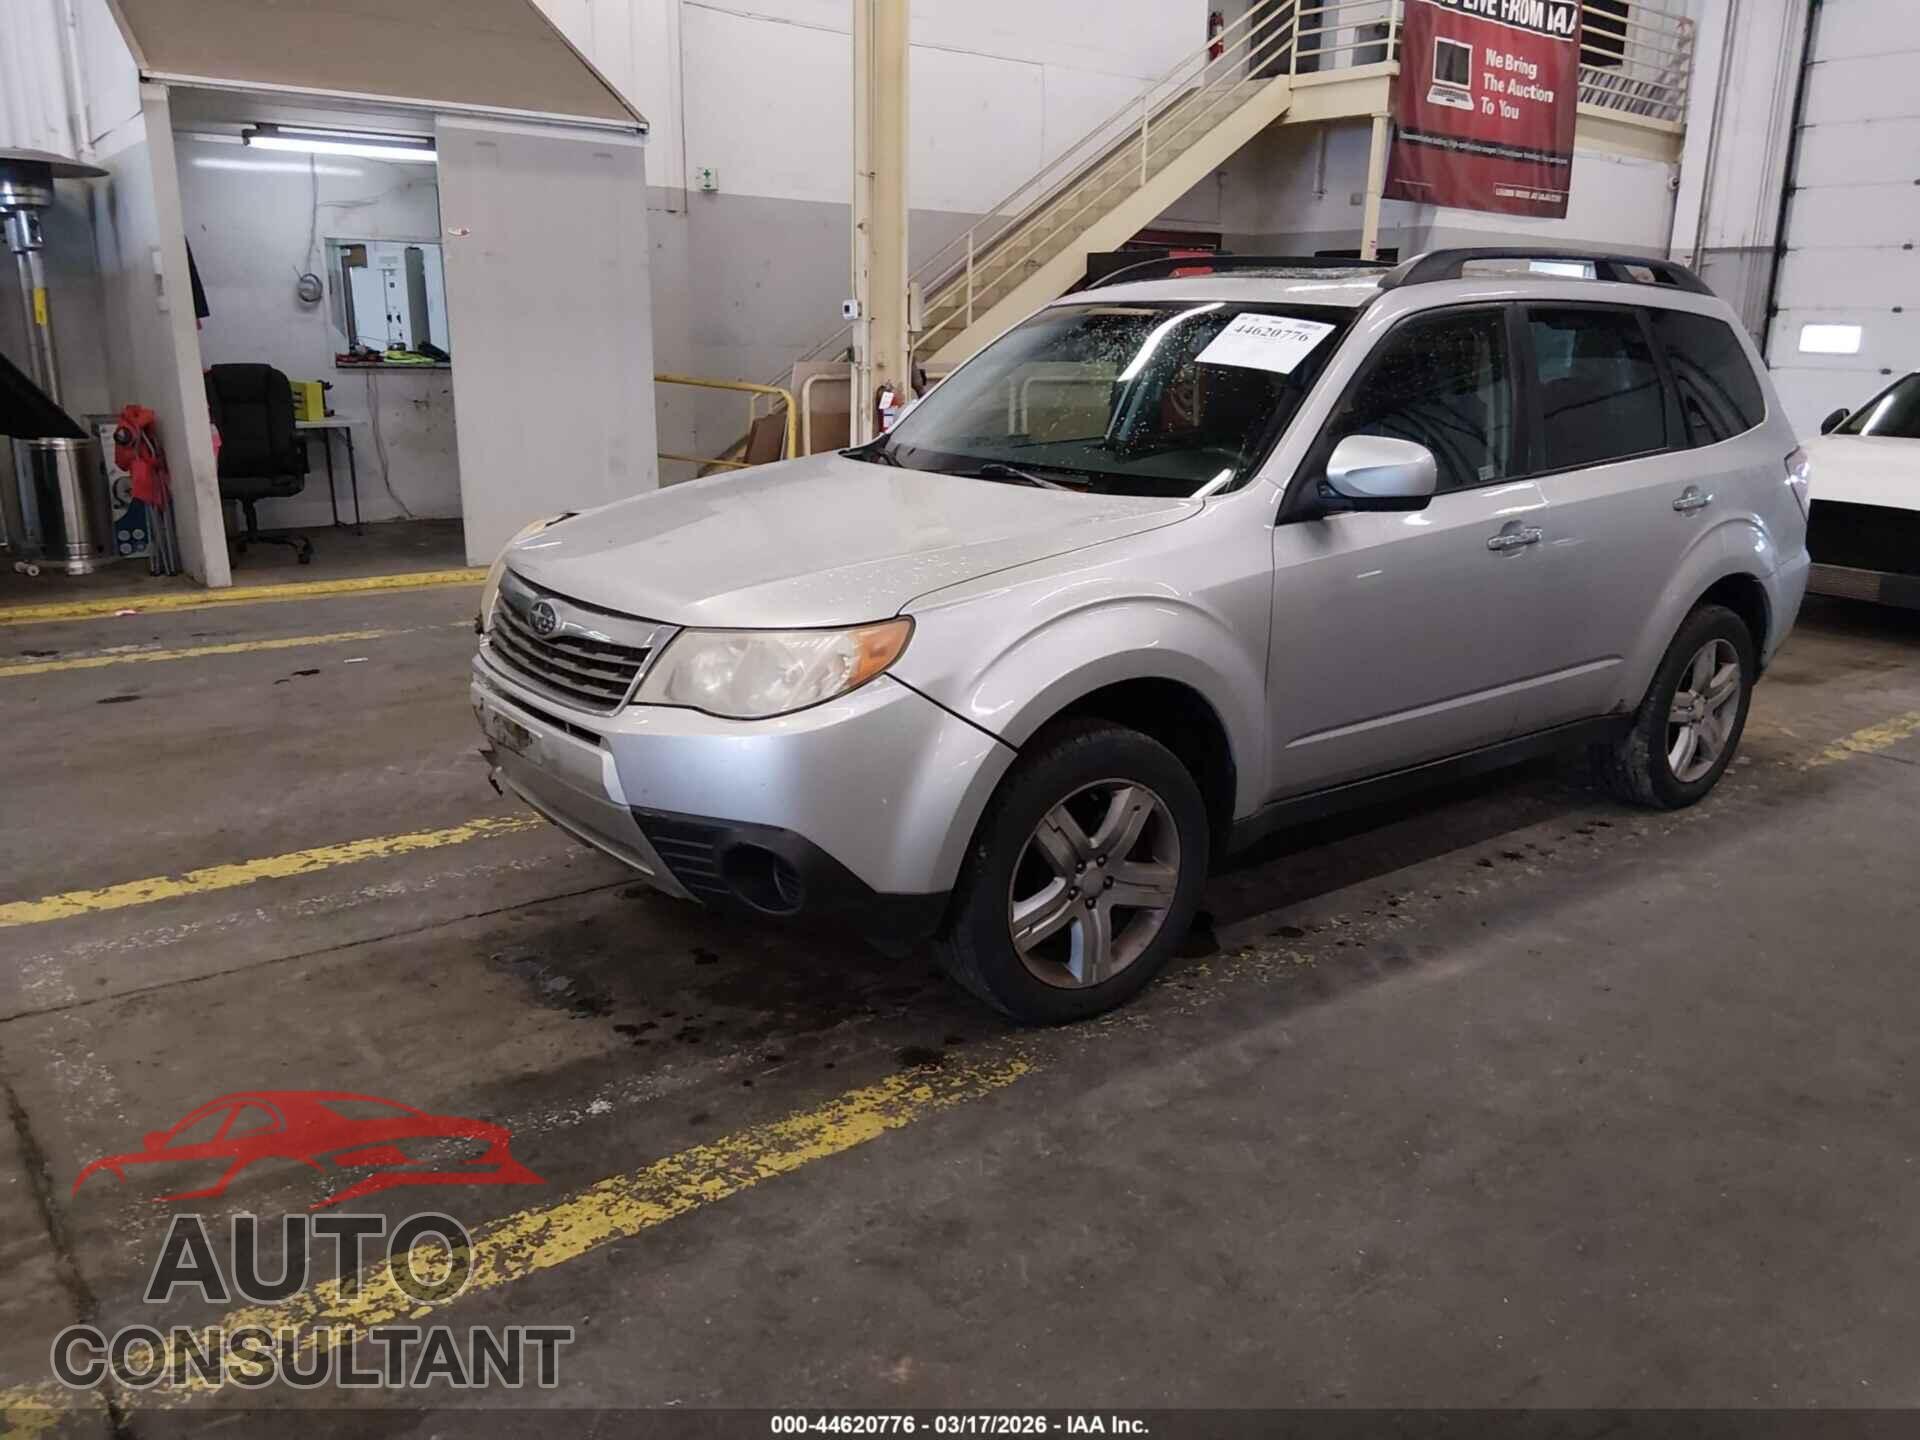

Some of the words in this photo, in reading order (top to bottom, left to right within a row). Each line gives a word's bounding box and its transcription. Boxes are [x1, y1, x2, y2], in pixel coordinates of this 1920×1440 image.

[1500, 0, 1545, 28] FROM
[1485, 47, 1504, 68] We
[1504, 53, 1538, 80] Bring
[1483, 72, 1505, 93] The
[1506, 78, 1554, 103] Auction
[1480, 95, 1495, 115] To
[1498, 99, 1520, 120] You
[1234, 323, 1309, 342] 44620776
